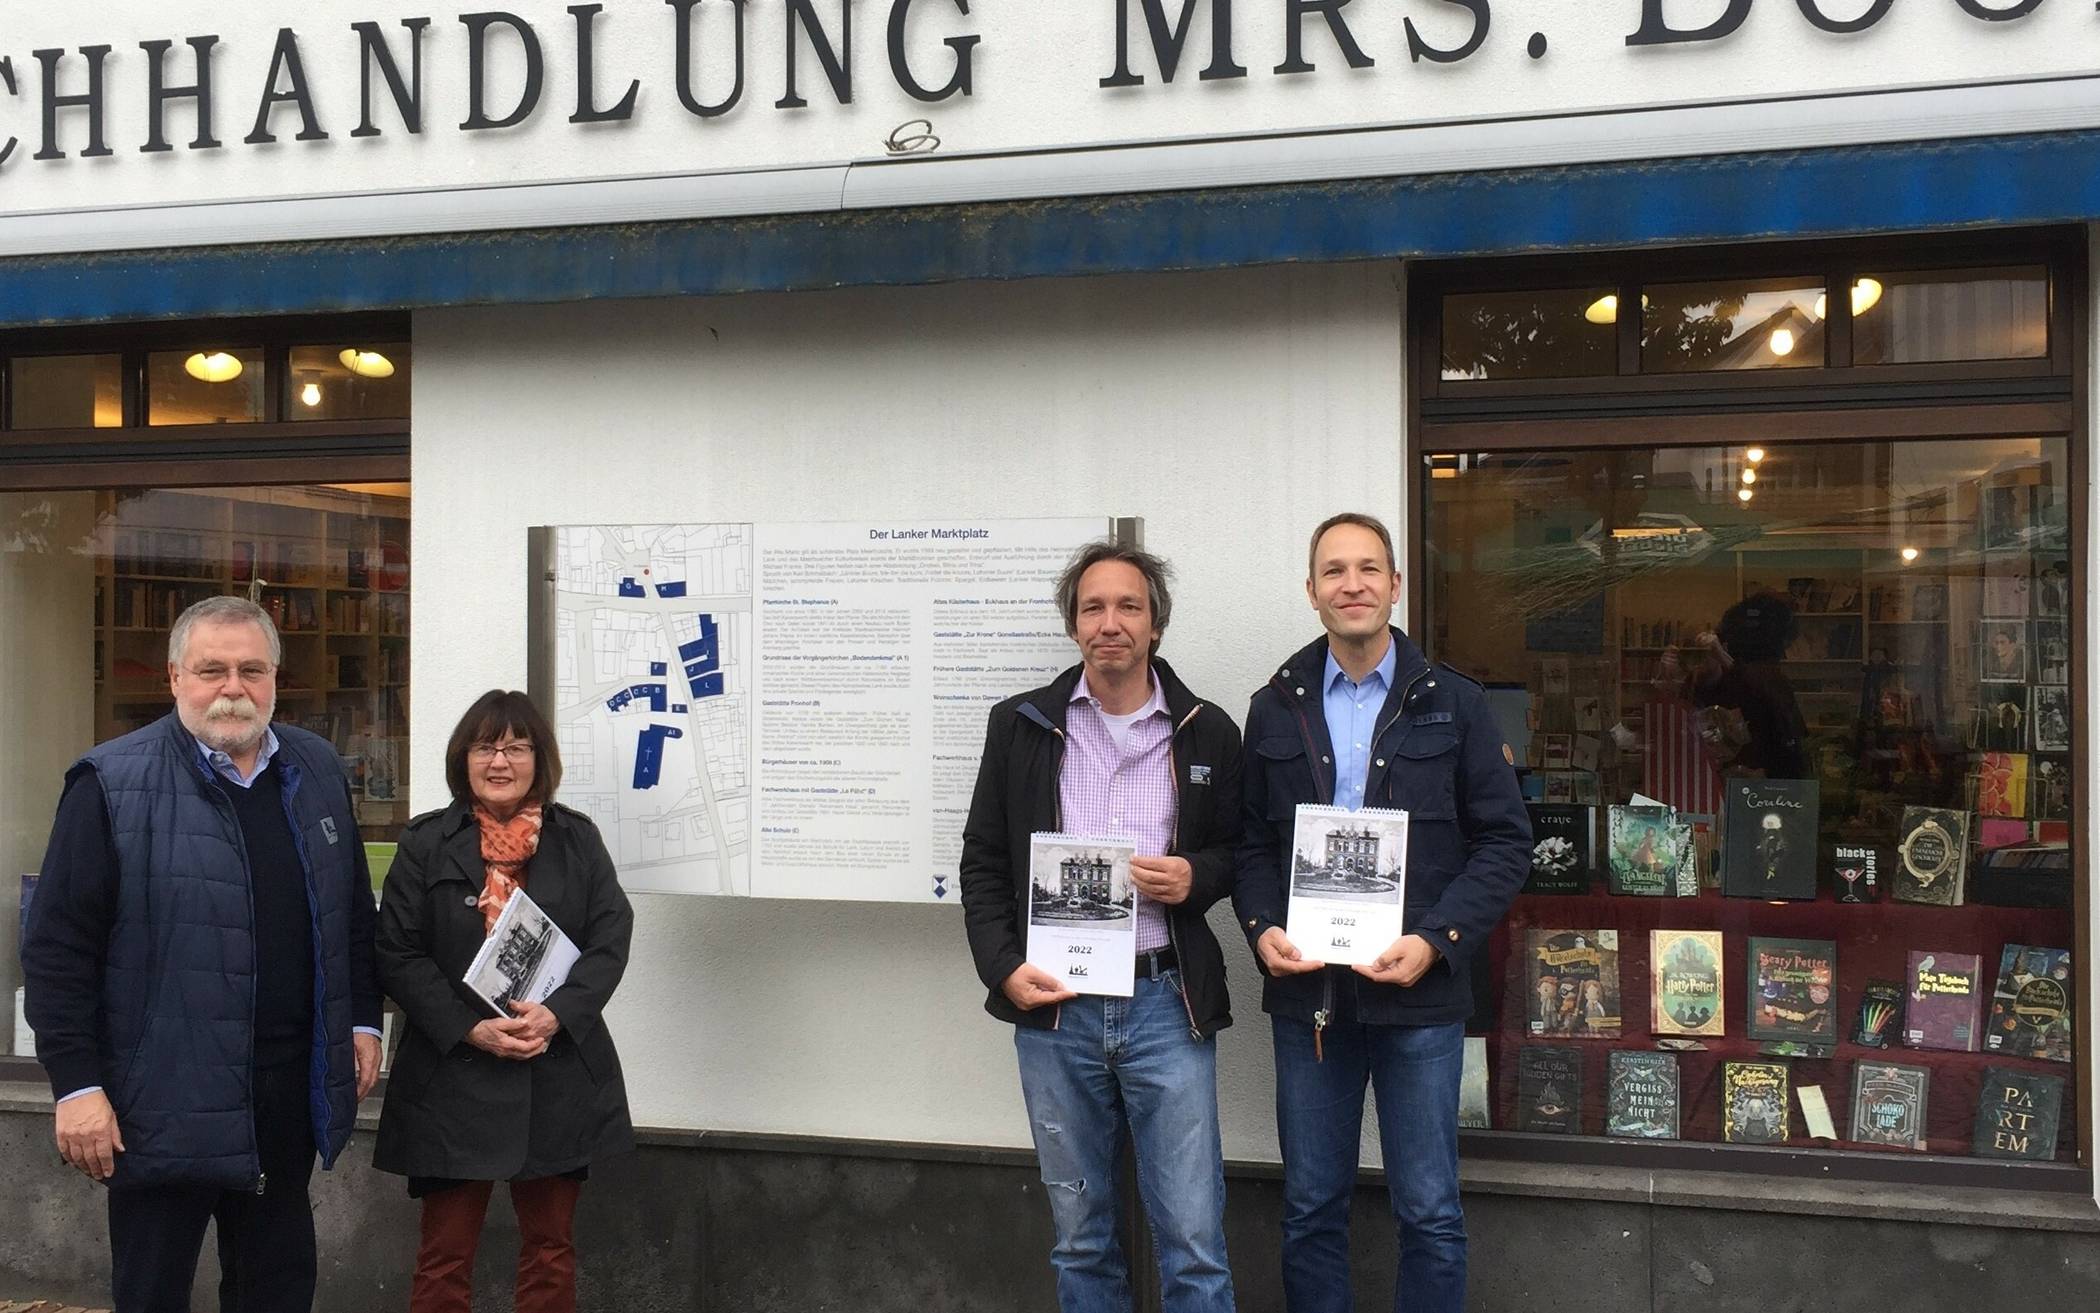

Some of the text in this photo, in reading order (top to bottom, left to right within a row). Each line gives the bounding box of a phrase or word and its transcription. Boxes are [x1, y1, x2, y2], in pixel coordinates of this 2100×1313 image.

[0, 0, 981, 166] HHANDLUNG
[869, 528, 989, 540] Der Lanker Marktplatz
[1746, 792, 1804, 809] Coraline
[1540, 816, 1572, 825] crave
[1836, 847, 1866, 858] black
[1865, 849, 1878, 885] stories
[1331, 917, 1356, 926] 2022
[1068, 944, 1093, 954] 2022
[1794, 955, 1828, 968] Potter
[1665, 978, 1715, 994] Harry Potter
[1624, 1082, 1662, 1094] VERGISS
[1630, 1095, 1653, 1106] MEIN
[1628, 1105, 1655, 1119] NICHT
[1871, 1102, 1905, 1118] SCHOKO
[1876, 1115, 1897, 1128] LADE
[1993, 1131, 2029, 1153] EM
